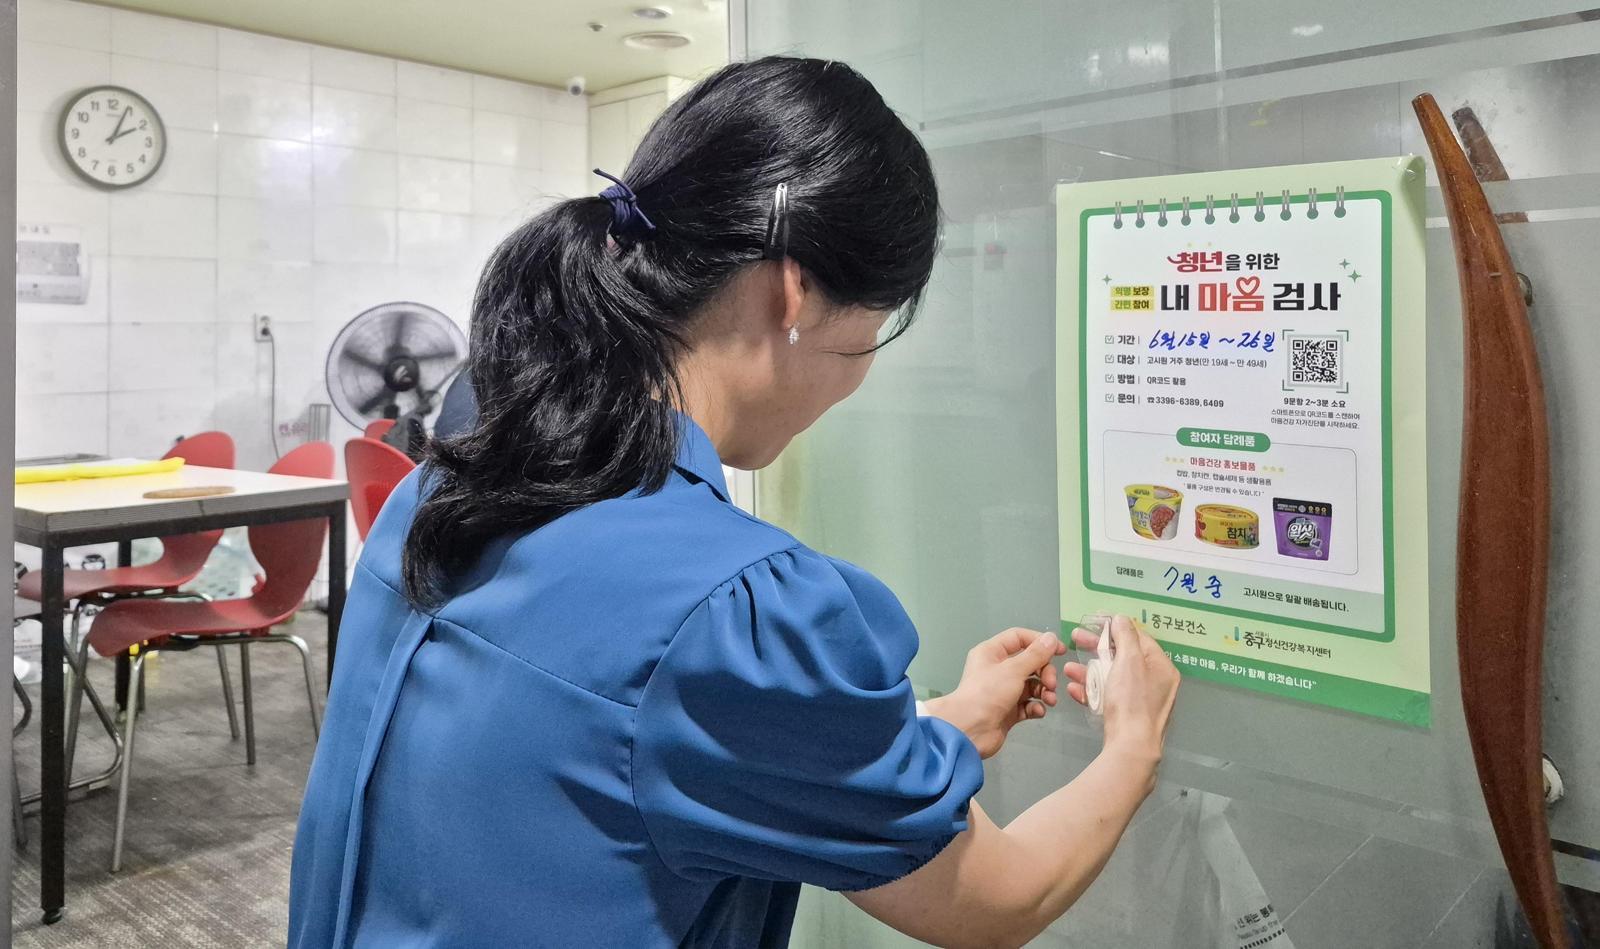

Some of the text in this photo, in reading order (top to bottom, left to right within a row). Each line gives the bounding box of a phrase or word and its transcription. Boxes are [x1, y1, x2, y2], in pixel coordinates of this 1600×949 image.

[90, 100, 99, 111] 11
[107, 98, 119, 110] 12
[77, 111, 89, 123] 10
[139, 119, 147, 130] 2
[71, 128, 80, 139] 9
[145, 136, 152, 148] 3
[78, 147, 86, 158] 8
[91, 159, 99, 170] 7
[138, 154, 146, 164] 4
[107, 165, 116, 177] 6
[126, 163, 134, 174] 5
[1167, 251, 1280, 273] 청년을 위한
[1133, 286, 1149, 296] 보장
[1161, 276, 1341, 312] 내 마음 검사
[1133, 300, 1149, 309] 참여
[1117, 335, 1135, 345] 기간
[1117, 354, 1135, 365] 대상
[1147, 356, 1168, 365] 고시원
[1170, 357, 1184, 365] 거주
[1212, 358, 1228, 366] 19세
[1237, 359, 1244, 367] 만
[1247, 359, 1267, 368] 49세)
[1117, 374, 1186, 386] 방법 QR코드 활용
[1117, 393, 1135, 404] 문의
[1283, 397, 1346, 408] 9문항 2~3분 소요
[1271, 409, 1360, 420] 스마트폰으로 QR코드를 스캔하여
[1271, 417, 1294, 425] 마음건강
[1189, 431, 1255, 448] 참여자 답례품
[1190, 457, 1256, 471] 마음건강 홍보물품
[1116, 566, 1144, 579] 답례품은
[1164, 566, 1222, 598] 7월 중
[1243, 587, 1349, 612] 고시원으로 일괄 배송됩니다.
[1151, 613, 1207, 635] 중구보건소
[1174, 654, 1198, 666] 소중한
[1221, 662, 1247, 677] 우리가
[1248, 668, 1266, 681] 함께
